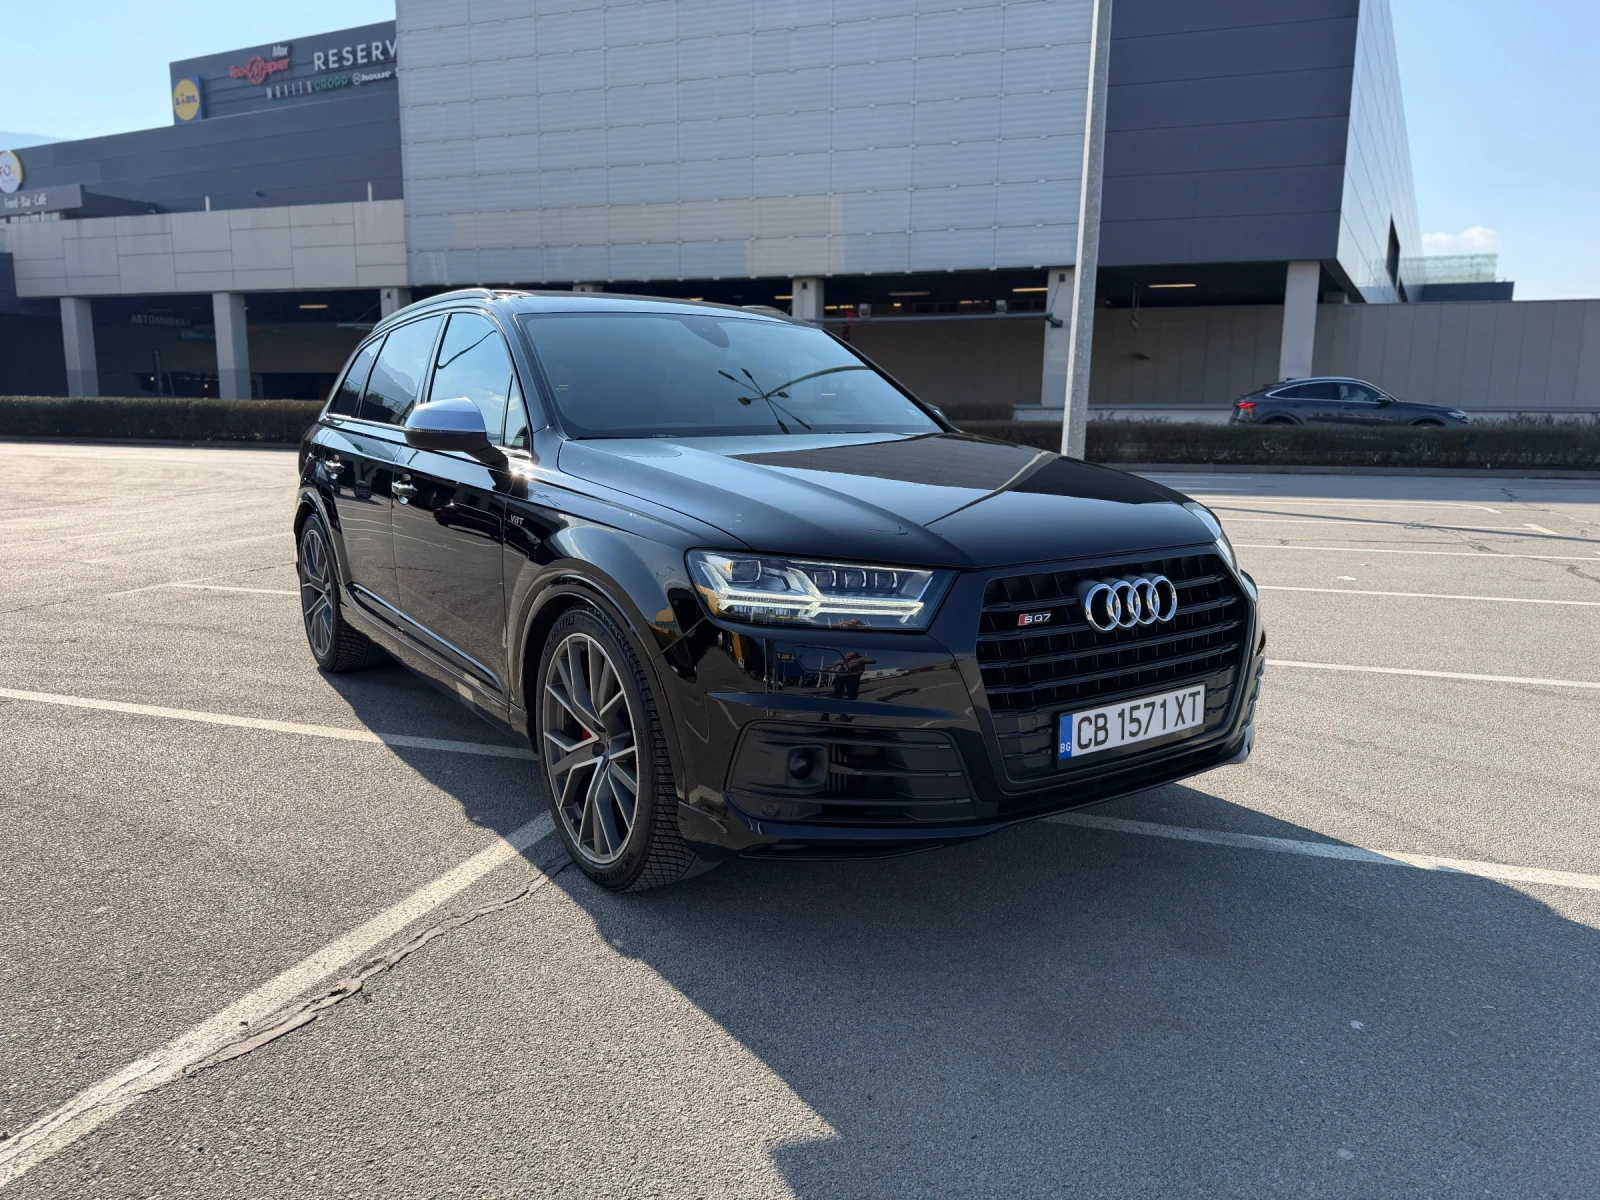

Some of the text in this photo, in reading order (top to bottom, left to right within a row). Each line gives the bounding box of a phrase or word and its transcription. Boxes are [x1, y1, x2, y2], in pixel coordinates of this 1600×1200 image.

[314, 75, 348, 91] CROPP
[1023, 613, 1051, 624] SQ7
[1077, 690, 1201, 750] CB 1571 XT
[1060, 742, 1072, 753] BG
